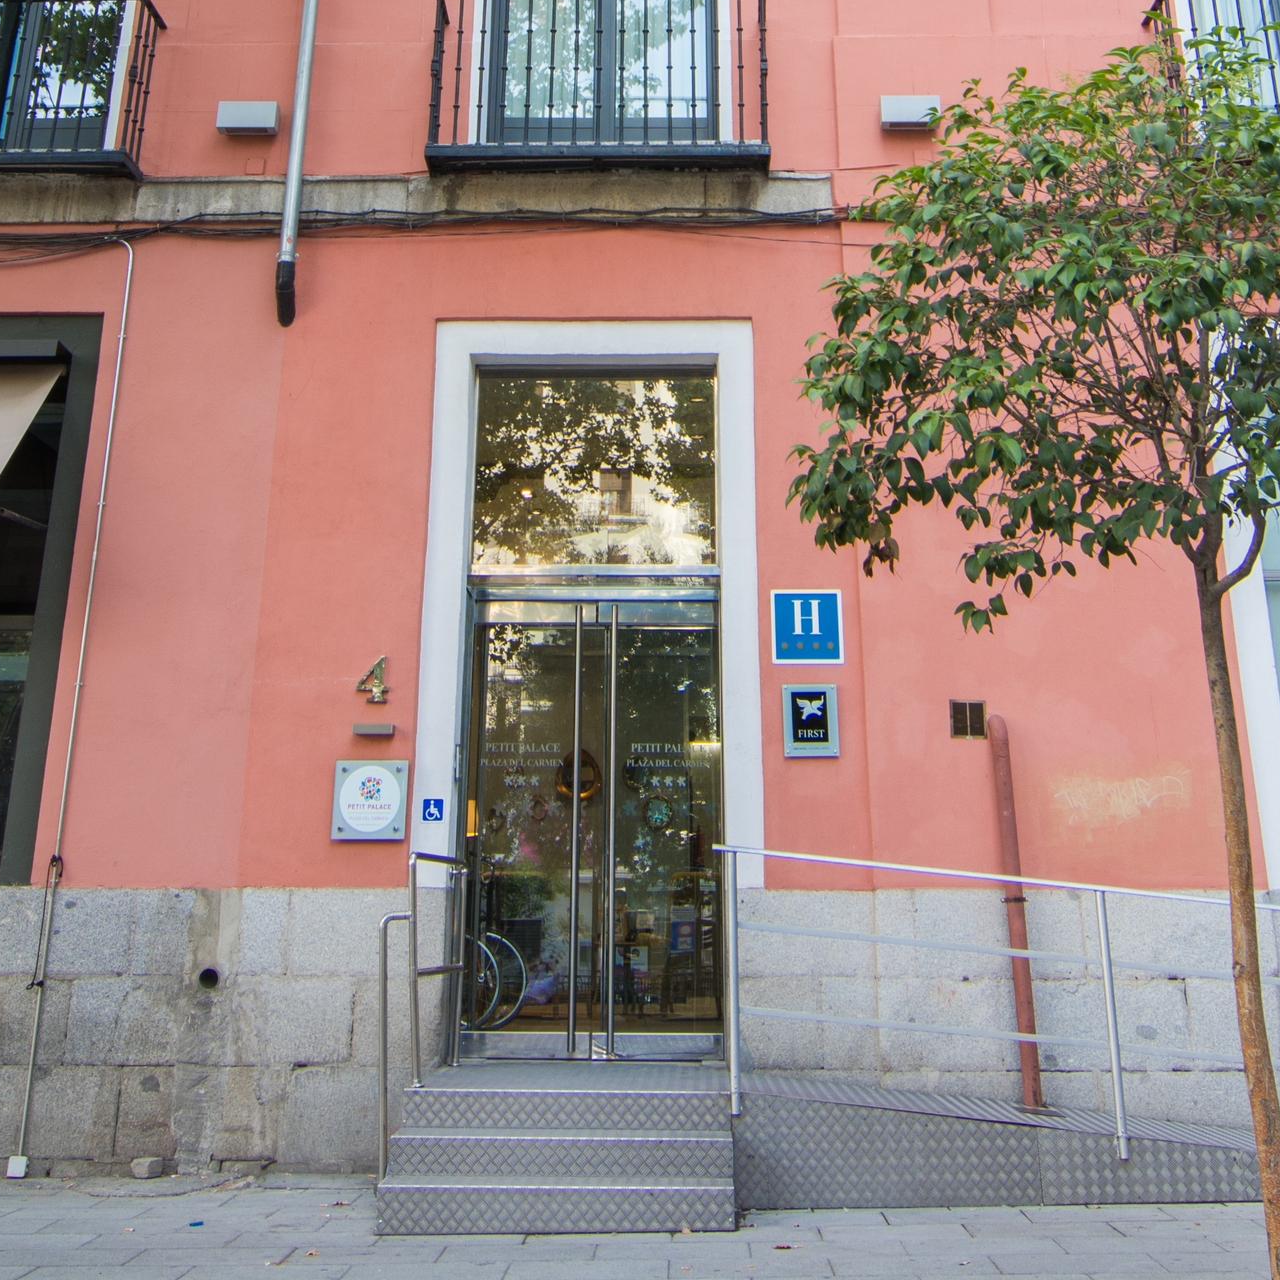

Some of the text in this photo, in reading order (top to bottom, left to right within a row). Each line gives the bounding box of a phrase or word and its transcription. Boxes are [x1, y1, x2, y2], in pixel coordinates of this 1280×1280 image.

[790, 599, 823, 635] H
[356, 655, 390, 703] 4
[797, 729, 826, 739] FIRST
[485, 742, 561, 753] PETIT PALACE
[631, 742, 663, 753] PETIT
[480, 758, 565, 767] PLAZA DEL CARMEN
[626, 758, 655, 768] PLAZA
[655, 758, 673, 768] DEL
